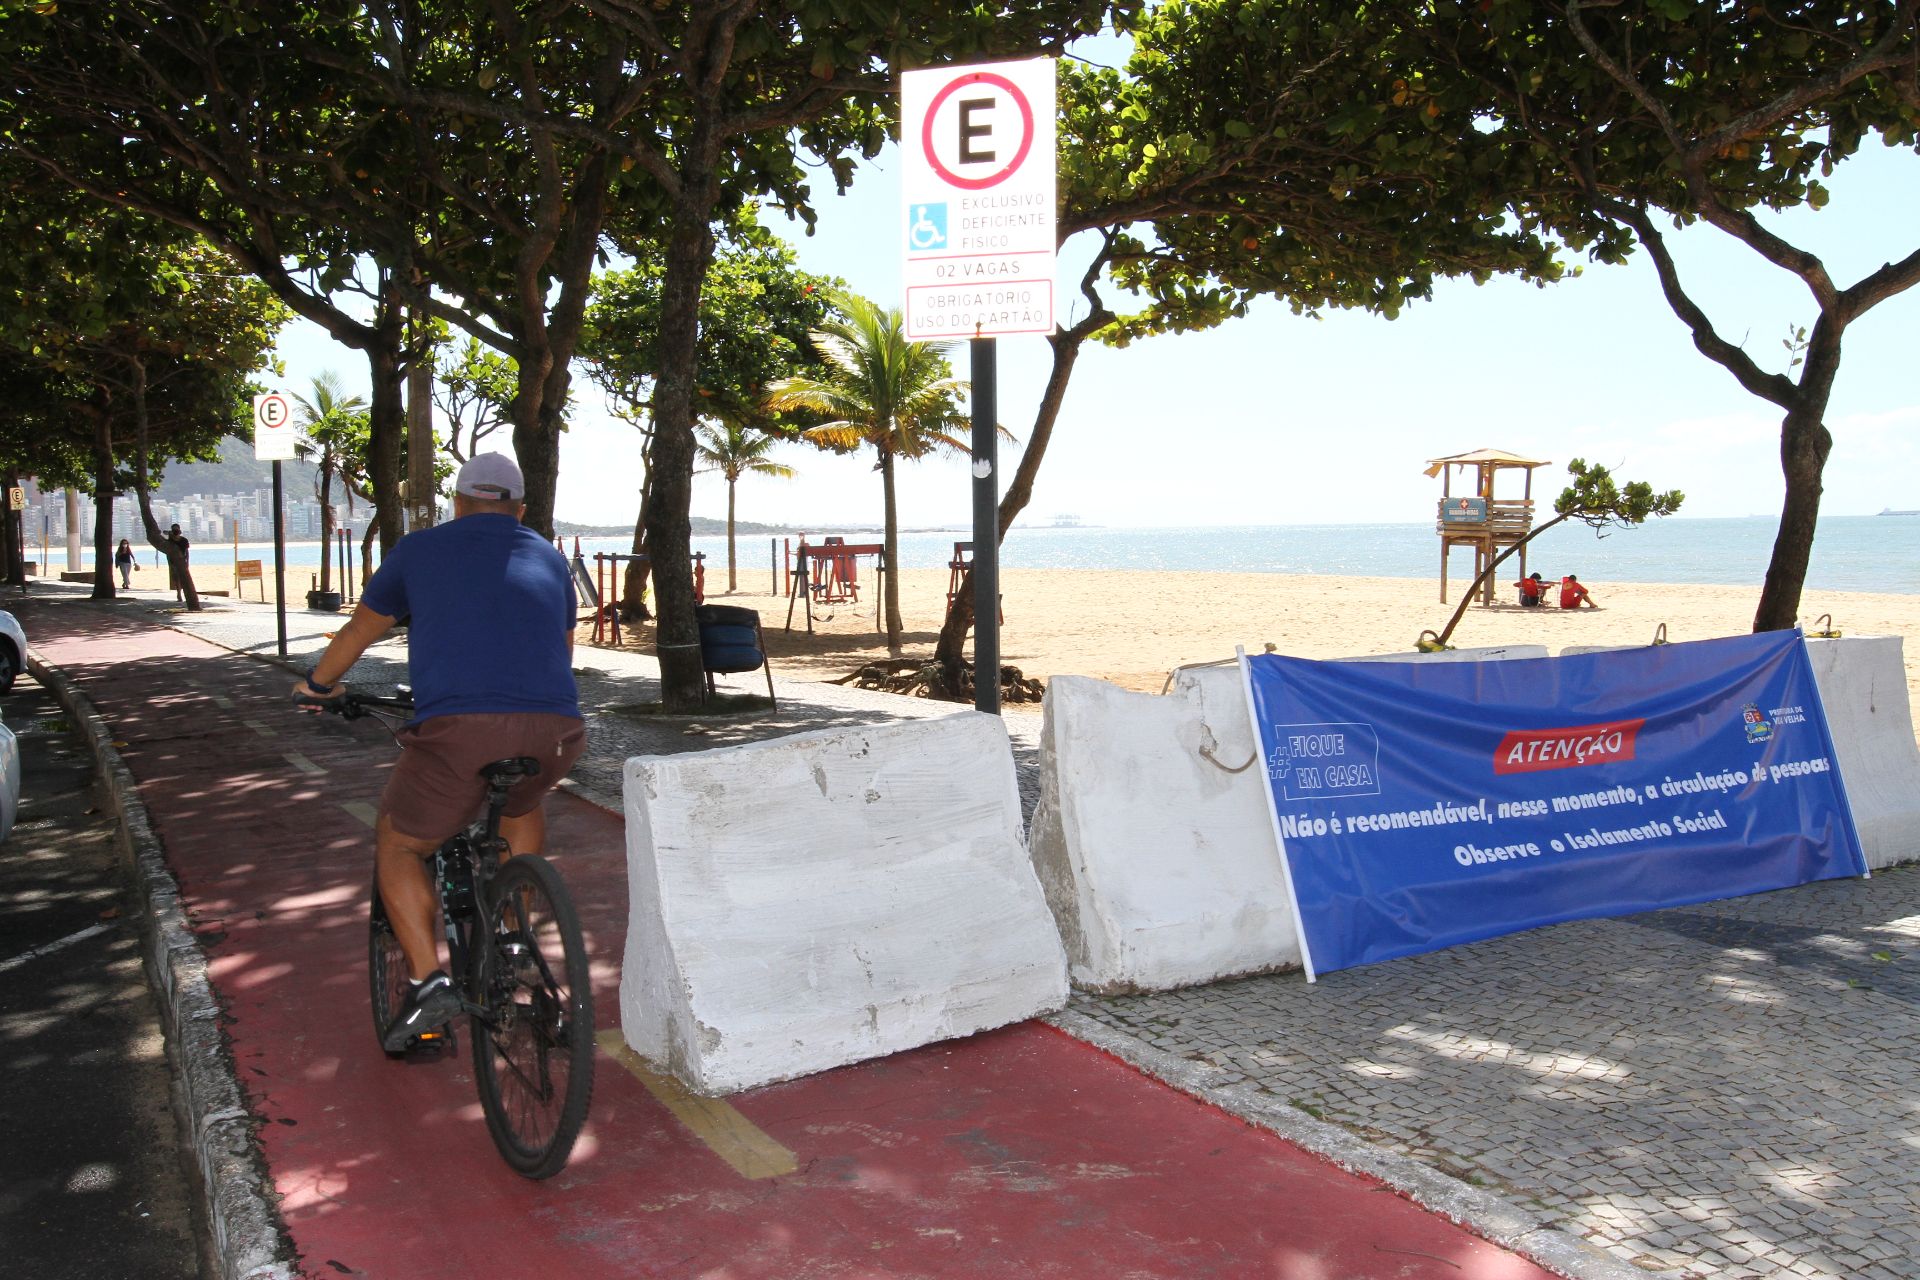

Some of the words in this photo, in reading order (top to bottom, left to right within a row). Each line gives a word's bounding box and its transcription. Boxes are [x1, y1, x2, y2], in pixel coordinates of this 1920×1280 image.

[959, 97, 995, 164] E
[962, 193, 1045, 210] EXCLUSIVO
[962, 213, 1046, 229] DEFICIENTE
[962, 235, 1009, 249] FISICO
[936, 265, 956, 278] 02
[963, 260, 1020, 277] VAGAS
[915, 315, 945, 328] USO
[951, 313, 971, 327] DO
[978, 307, 1043, 325] CARTÃO
[268, 403, 278, 421] E
[1784, 714, 1806, 725] VELHA
[1289, 734, 1345, 758] FIQUE
[1506, 728, 1622, 764] ATENÇÃO
[1296, 767, 1322, 789] EM
[1325, 764, 1373, 788] CASA
[1280, 813, 1328, 838] Não
[1330, 811, 1342, 834] é
[1346, 798, 1493, 834] recomendável,
[1498, 797, 1548, 820] nesse
[1551, 785, 1644, 813] momento,
[1645, 784, 1659, 800] a
[1661, 768, 1749, 794] circulação
[1751, 762, 1768, 783] de
[1769, 757, 1830, 784] pessoas
[1454, 841, 1542, 867] Observe
[1550, 838, 1565, 853] o
[1565, 820, 1672, 850] Isolamento
[1672, 809, 1728, 834] Social
